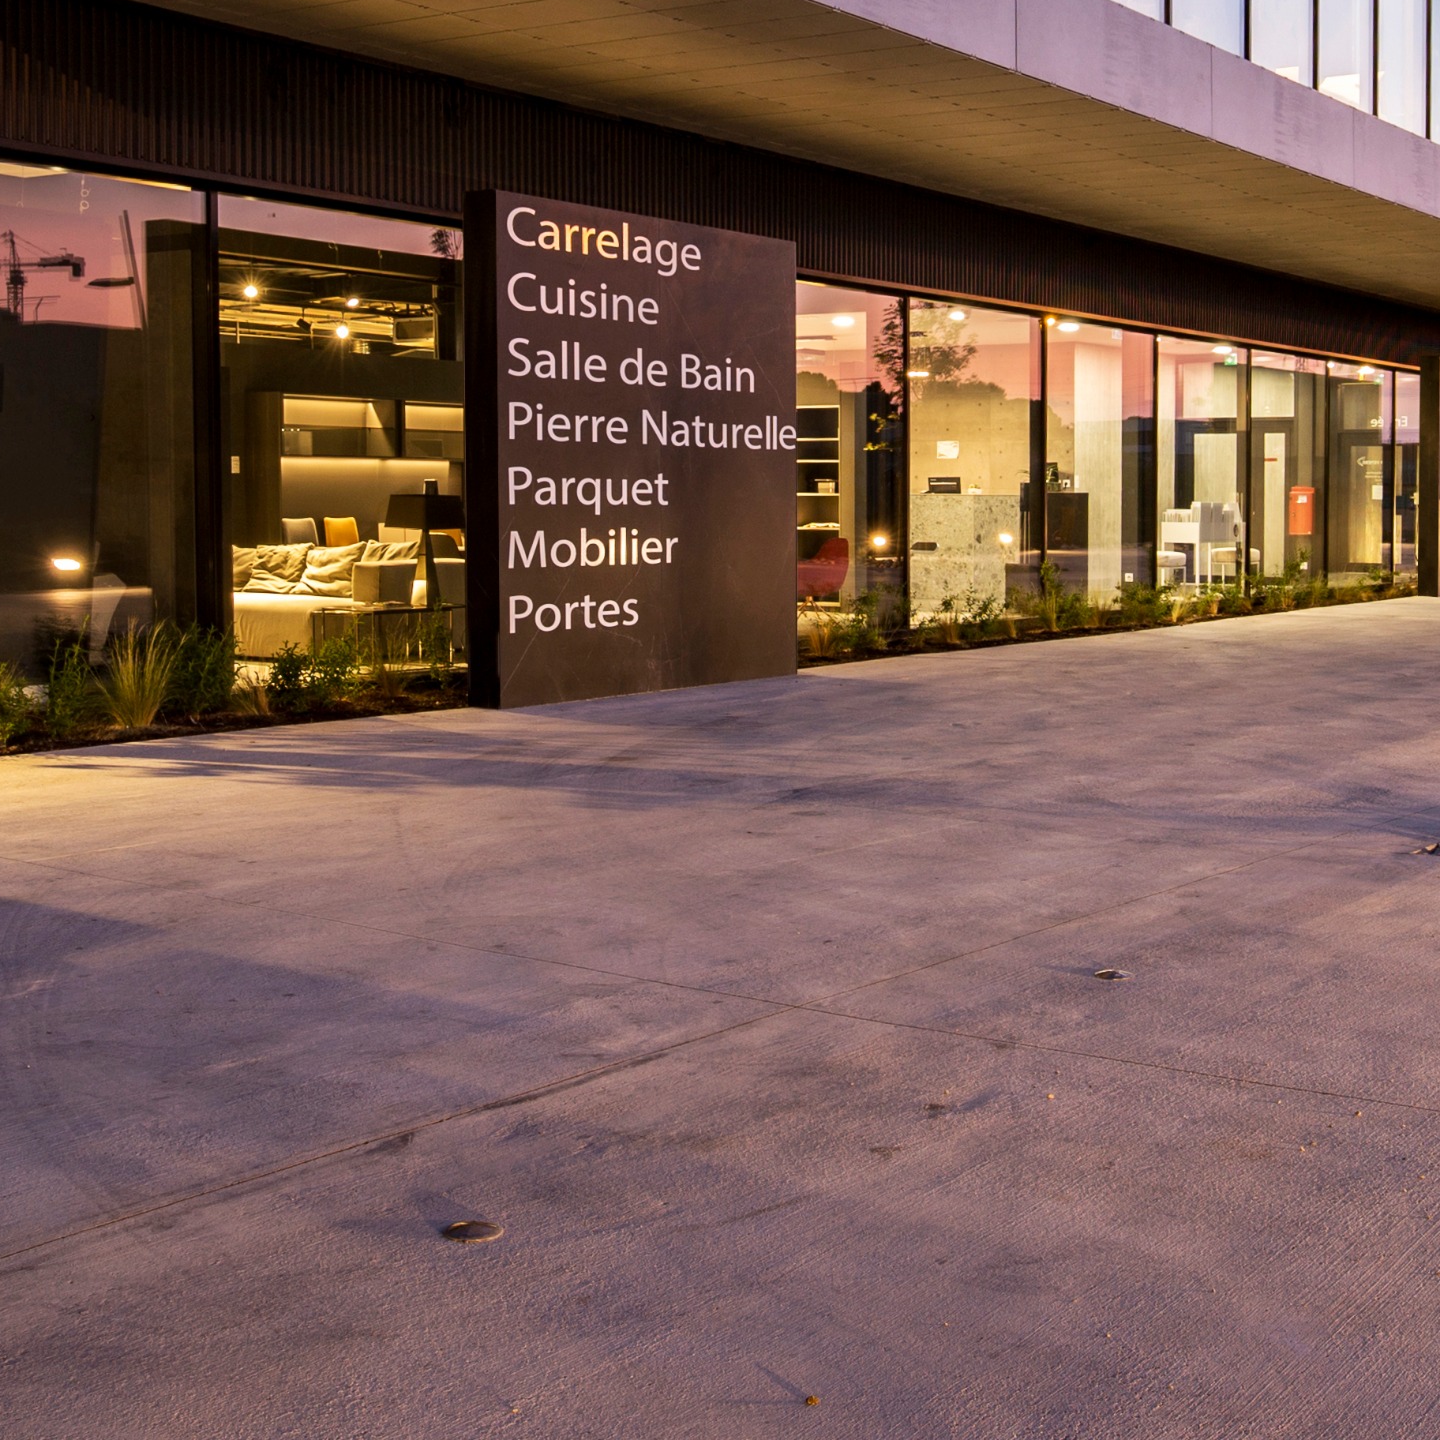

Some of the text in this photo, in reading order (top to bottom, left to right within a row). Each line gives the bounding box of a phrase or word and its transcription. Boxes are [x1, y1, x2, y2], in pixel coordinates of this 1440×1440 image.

[506, 206, 702, 277] Carrelage
[507, 271, 660, 326] Cuisine
[507, 337, 756, 393] Salle de Bain
[508, 401, 797, 451] Pierre Naturelle
[508, 466, 669, 516] Parquet
[508, 526, 679, 570] Mobilier
[509, 594, 639, 634] Portes
